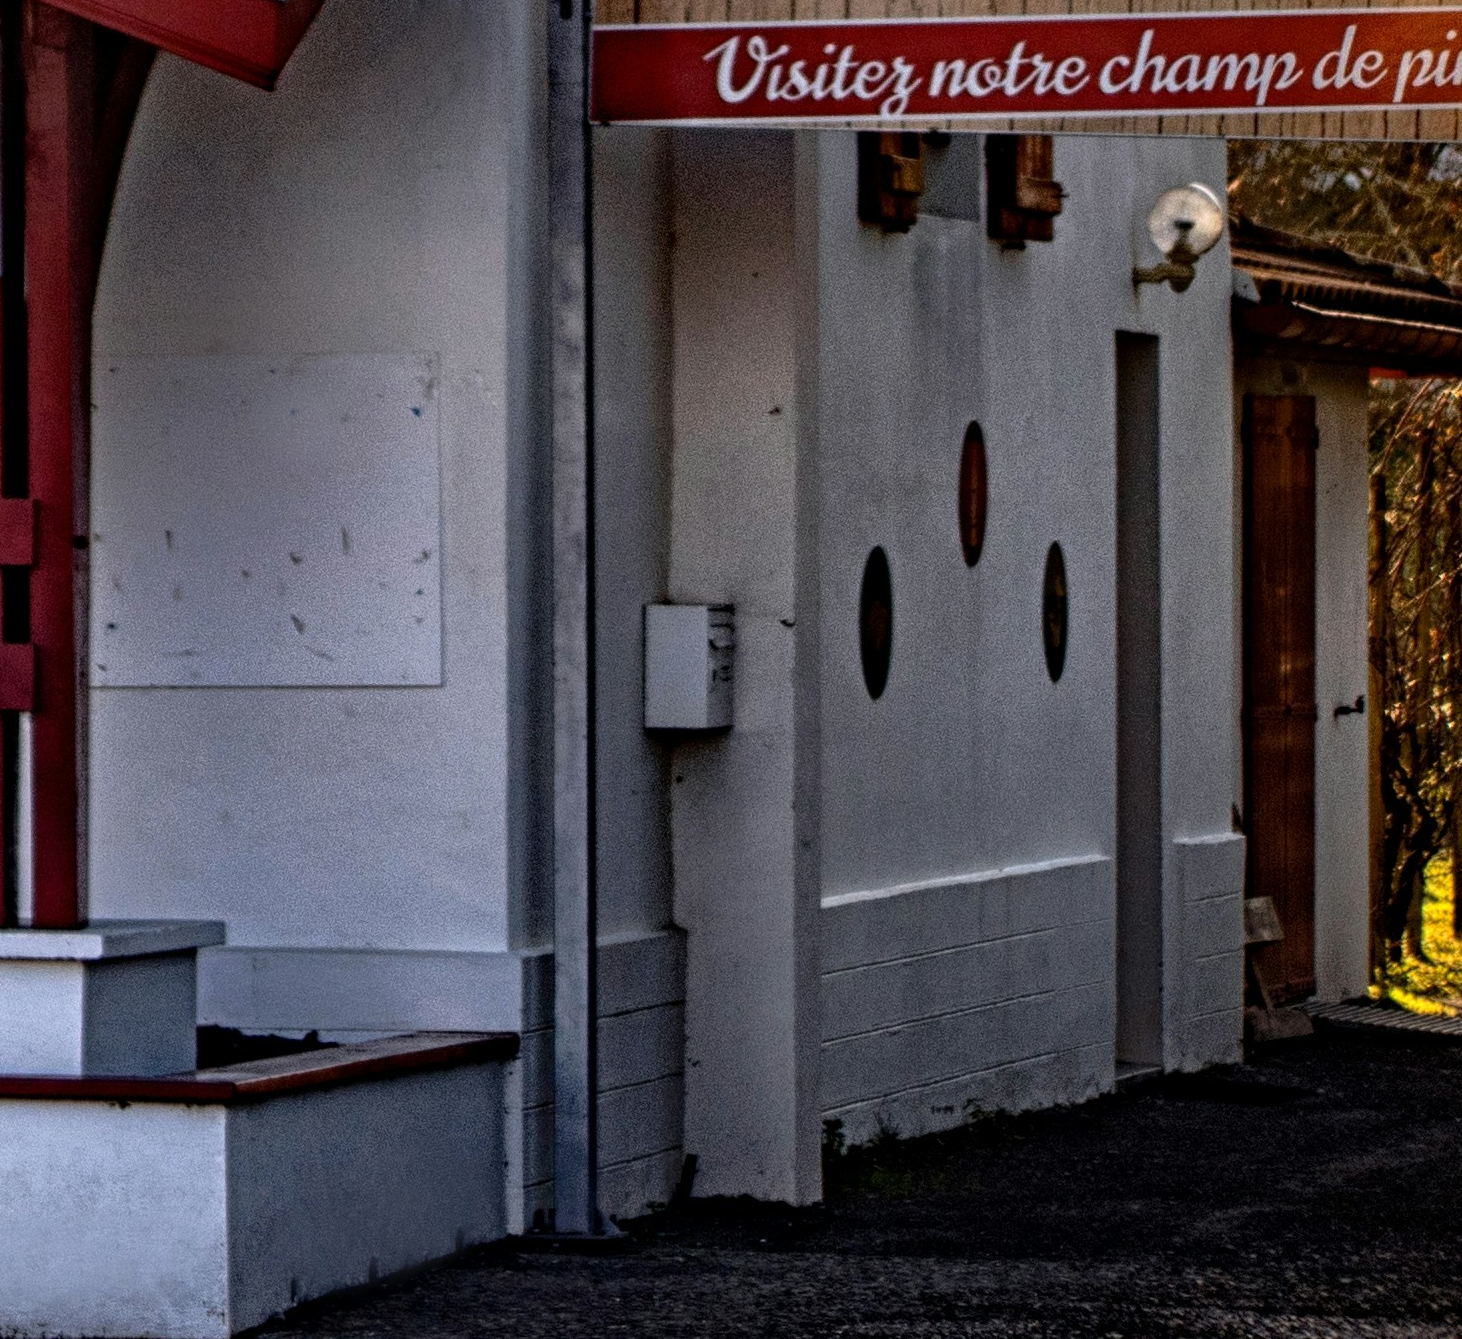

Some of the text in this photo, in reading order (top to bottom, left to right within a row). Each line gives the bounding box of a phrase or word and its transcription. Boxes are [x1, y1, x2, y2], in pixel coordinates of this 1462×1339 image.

[701, 34, 921, 120] Visitez
[928, 40, 1090, 98] notre
[1098, 28, 1303, 106] champ
[1311, 24, 1388, 90] de
